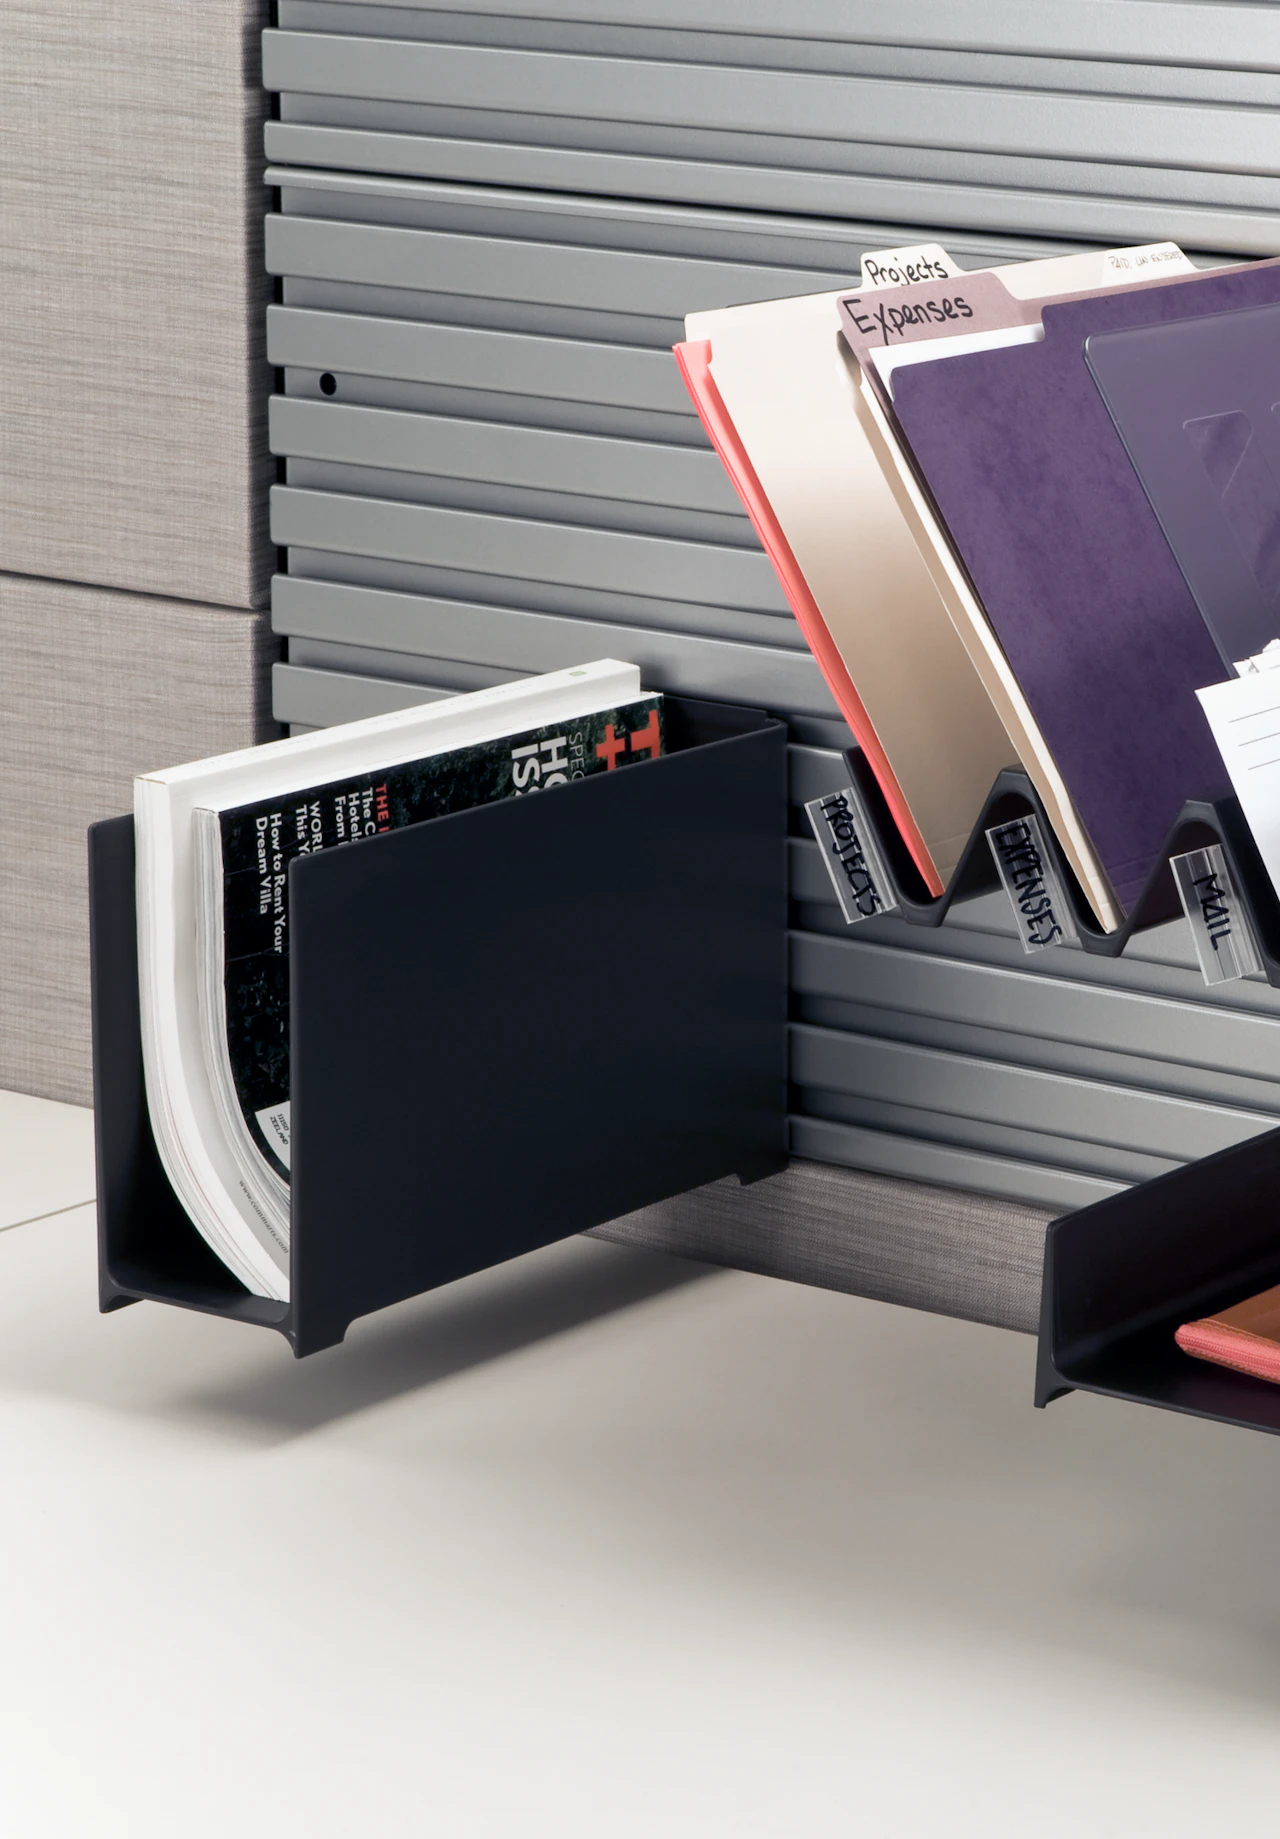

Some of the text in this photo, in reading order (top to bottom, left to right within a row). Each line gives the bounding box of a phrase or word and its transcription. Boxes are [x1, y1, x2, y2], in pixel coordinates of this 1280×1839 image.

[864, 255, 949, 286] Projects
[843, 297, 973, 346] Expenses
[511, 744, 540, 797] IS
[295, 804, 308, 840] This
[334, 796, 348, 838] From
[362, 787, 375, 818] The
[375, 783, 390, 821] THE
[255, 816, 272, 915] Dream Villa
[820, 794, 881, 917] PROJECTS
[269, 812, 287, 954] How to Rent Your
[996, 822, 1063, 946] EXPENSES
[1192, 873, 1232, 951] MAIL
[269, 1116, 289, 1145] ZEELAND
[239, 1180, 289, 1255] www.commarts.com
